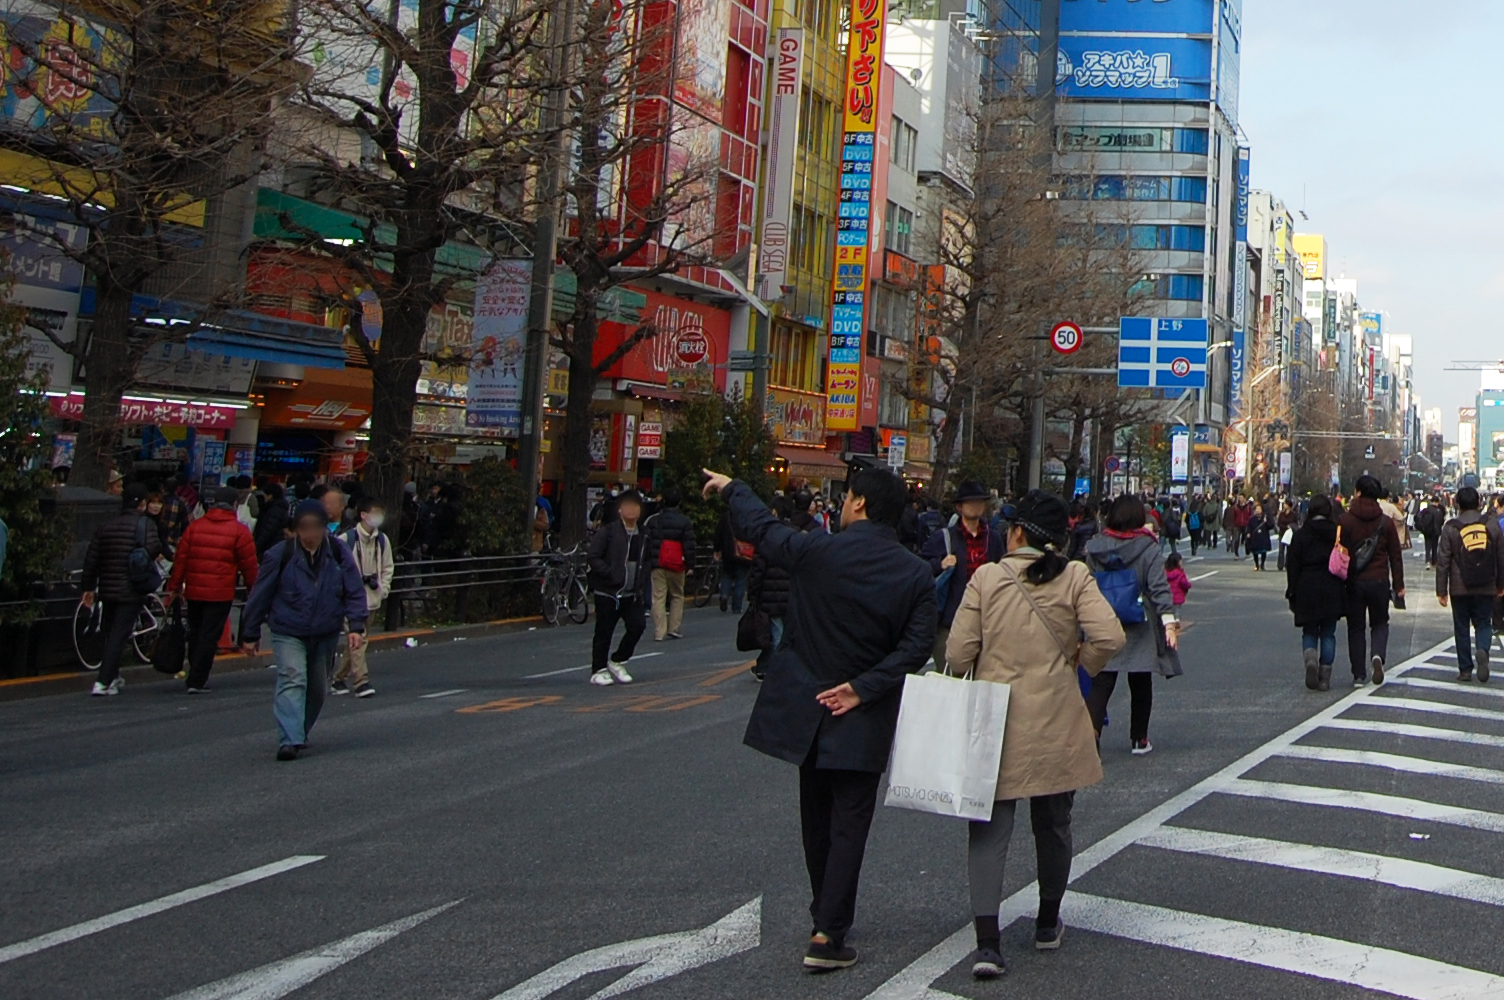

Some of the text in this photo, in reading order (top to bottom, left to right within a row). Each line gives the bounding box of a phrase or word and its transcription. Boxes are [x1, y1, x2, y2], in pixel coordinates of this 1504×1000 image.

[776, 37, 799, 96] GAME
[1074, 68, 1153, 88] ソフマップ
[857, 133, 874, 144] 中古
[846, 149, 871, 161] DVD
[854, 161, 872, 173] 中古
[843, 178, 870, 189] DVD
[840, 190, 870, 201] 4F 中古
[841, 206, 868, 217] DVD
[838, 218, 868, 230] 3F 中古
[761, 221, 788, 275] CLUB SEGA
[834, 292, 863, 303] 1F 中古
[478, 306, 529, 317] 元気なアキバ
[833, 320, 861, 332] DVD
[1158, 320, 1184, 332] 上野
[1057, 330, 1076, 345] 50
[309, 399, 350, 419] Hey
[640, 424, 662, 433] GAME
[639, 447, 661, 457] GAME
